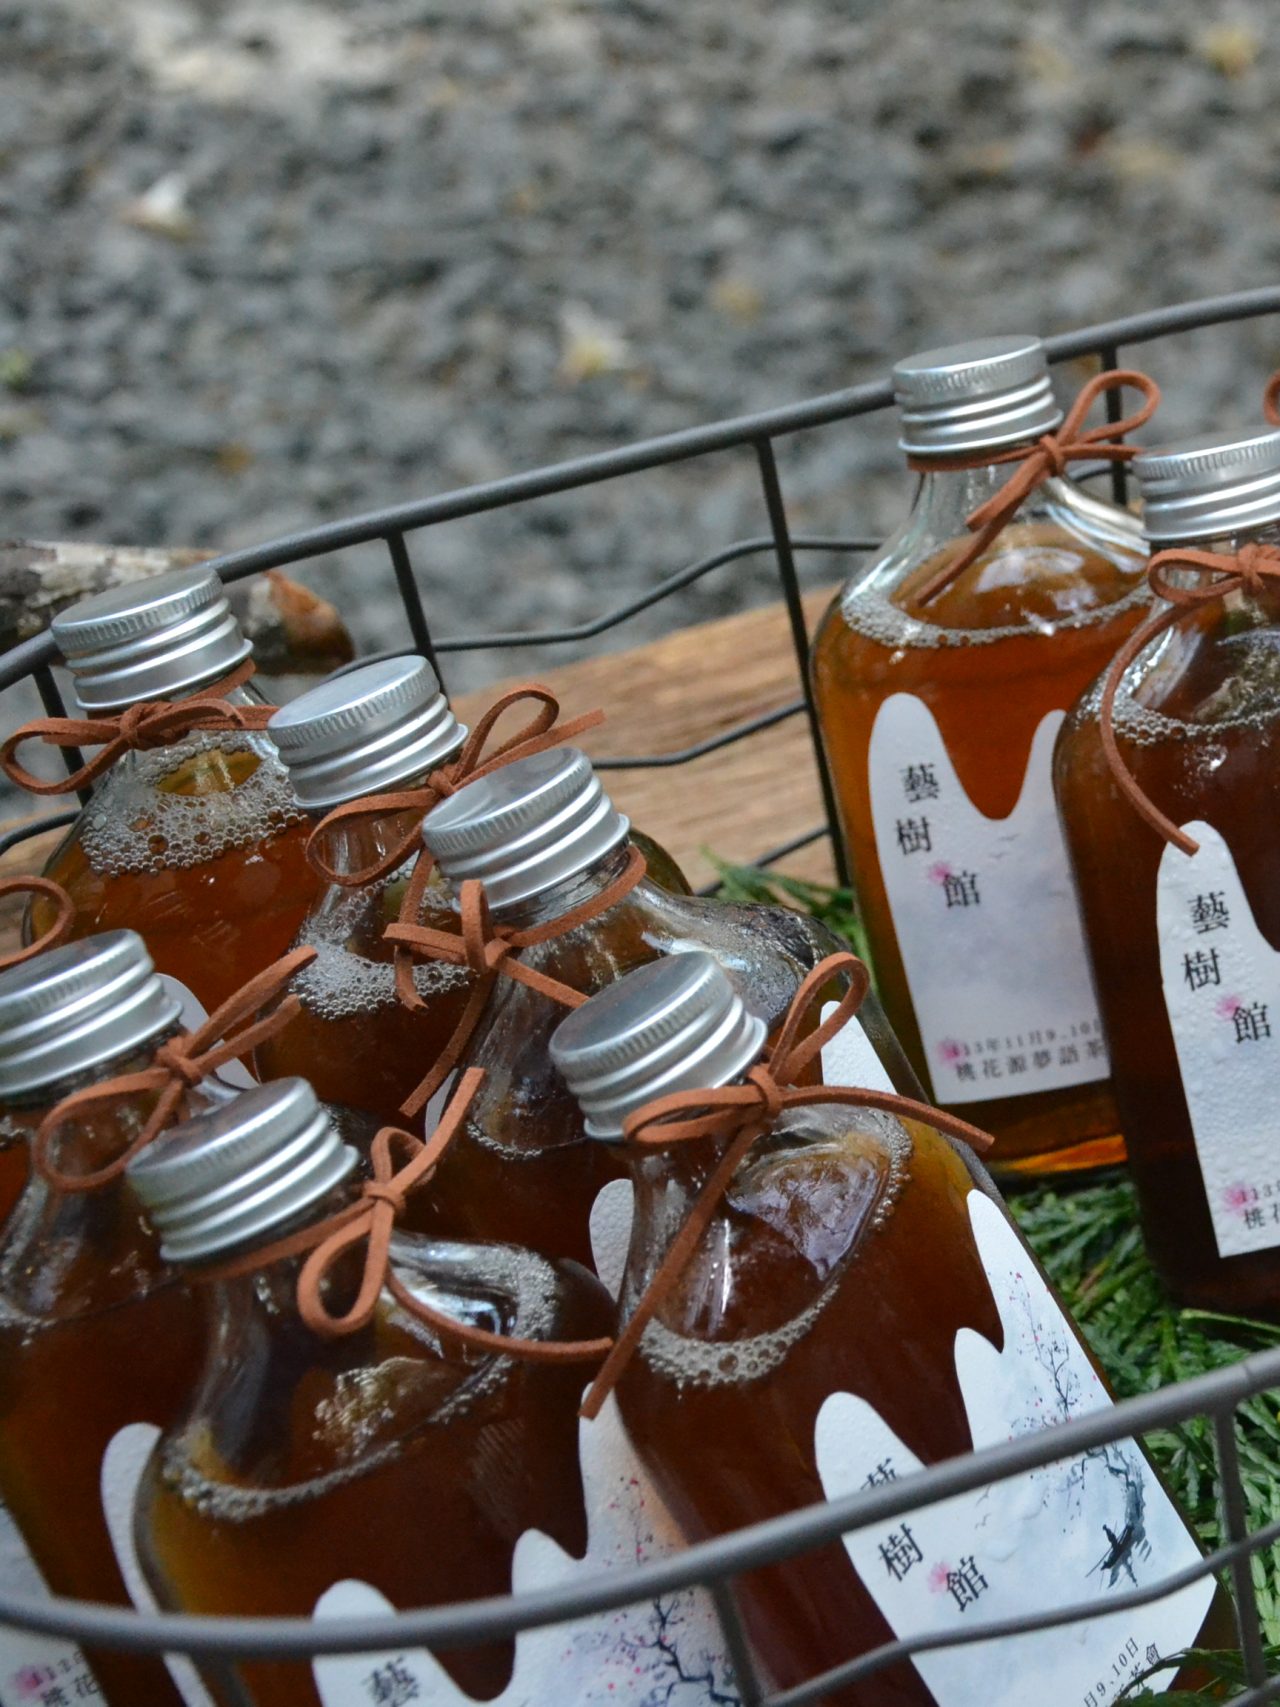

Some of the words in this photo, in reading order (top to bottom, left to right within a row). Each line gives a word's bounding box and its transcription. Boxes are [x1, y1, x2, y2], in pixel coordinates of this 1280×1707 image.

[897, 763, 982, 909] 藝樹館
[1181, 891, 1273, 1045] 藝樹館
